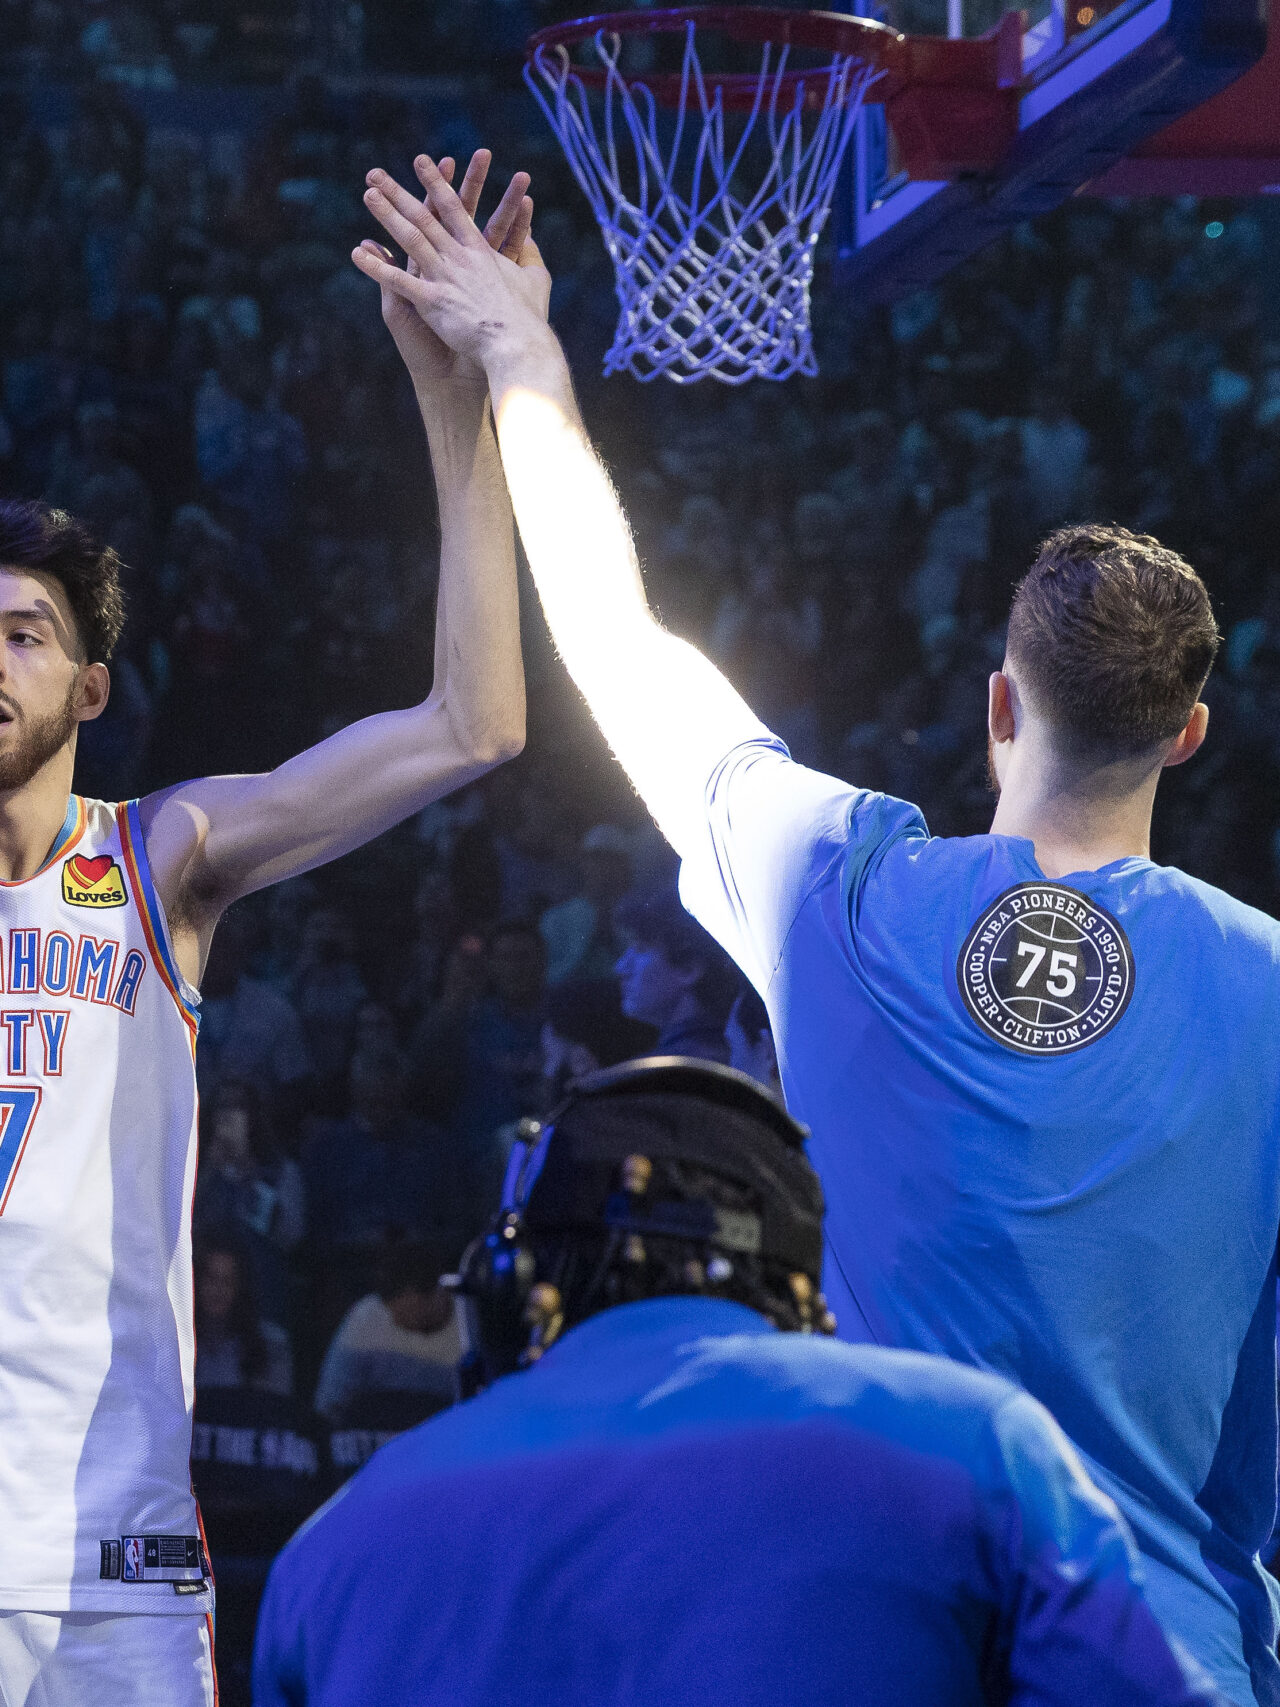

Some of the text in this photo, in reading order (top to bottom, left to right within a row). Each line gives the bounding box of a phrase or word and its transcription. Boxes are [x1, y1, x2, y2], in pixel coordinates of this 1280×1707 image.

[981, 893, 1121, 964] NBA PIONEERS 1950
[970, 952, 1123, 1046] COOPER CLIFTON LLOYD
[1015, 941, 1079, 998] 75
